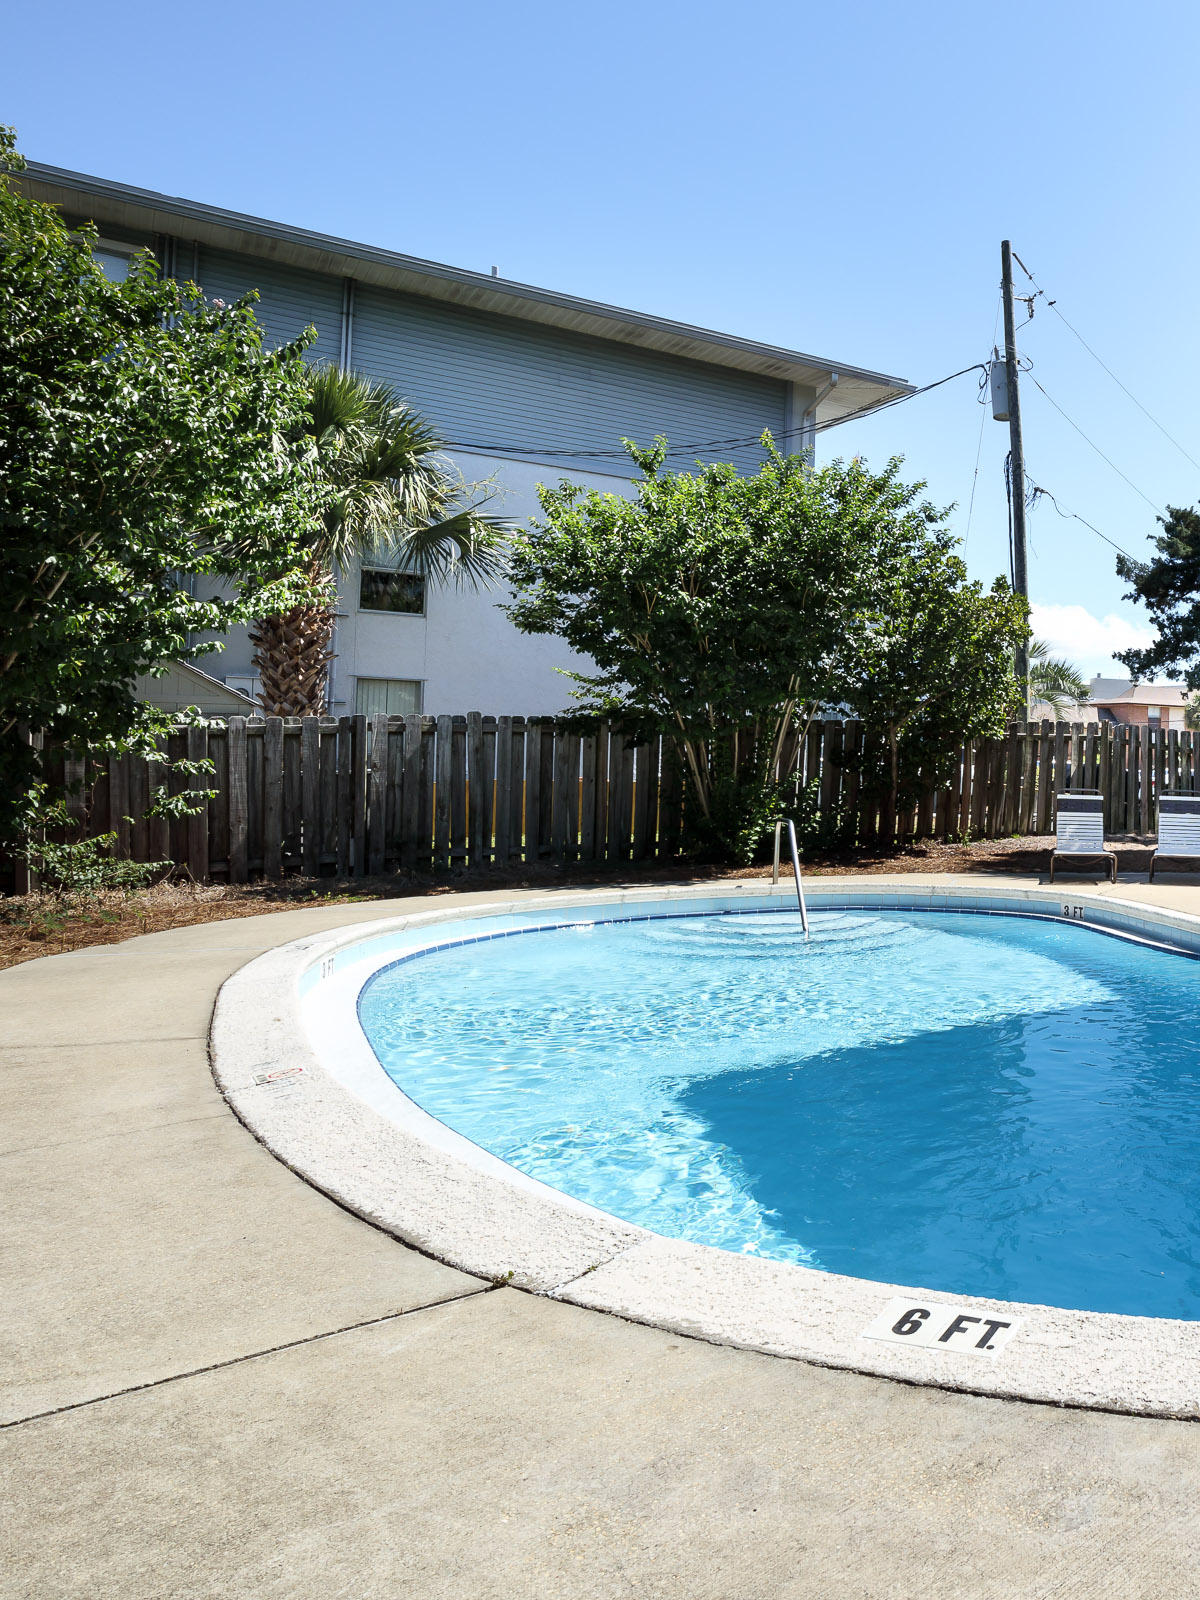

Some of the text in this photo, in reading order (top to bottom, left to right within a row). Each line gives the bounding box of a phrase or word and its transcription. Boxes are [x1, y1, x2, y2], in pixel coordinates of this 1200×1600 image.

[1064, 905, 1070, 917] 3
[892, 1308, 1012, 1351] 6 FT.
